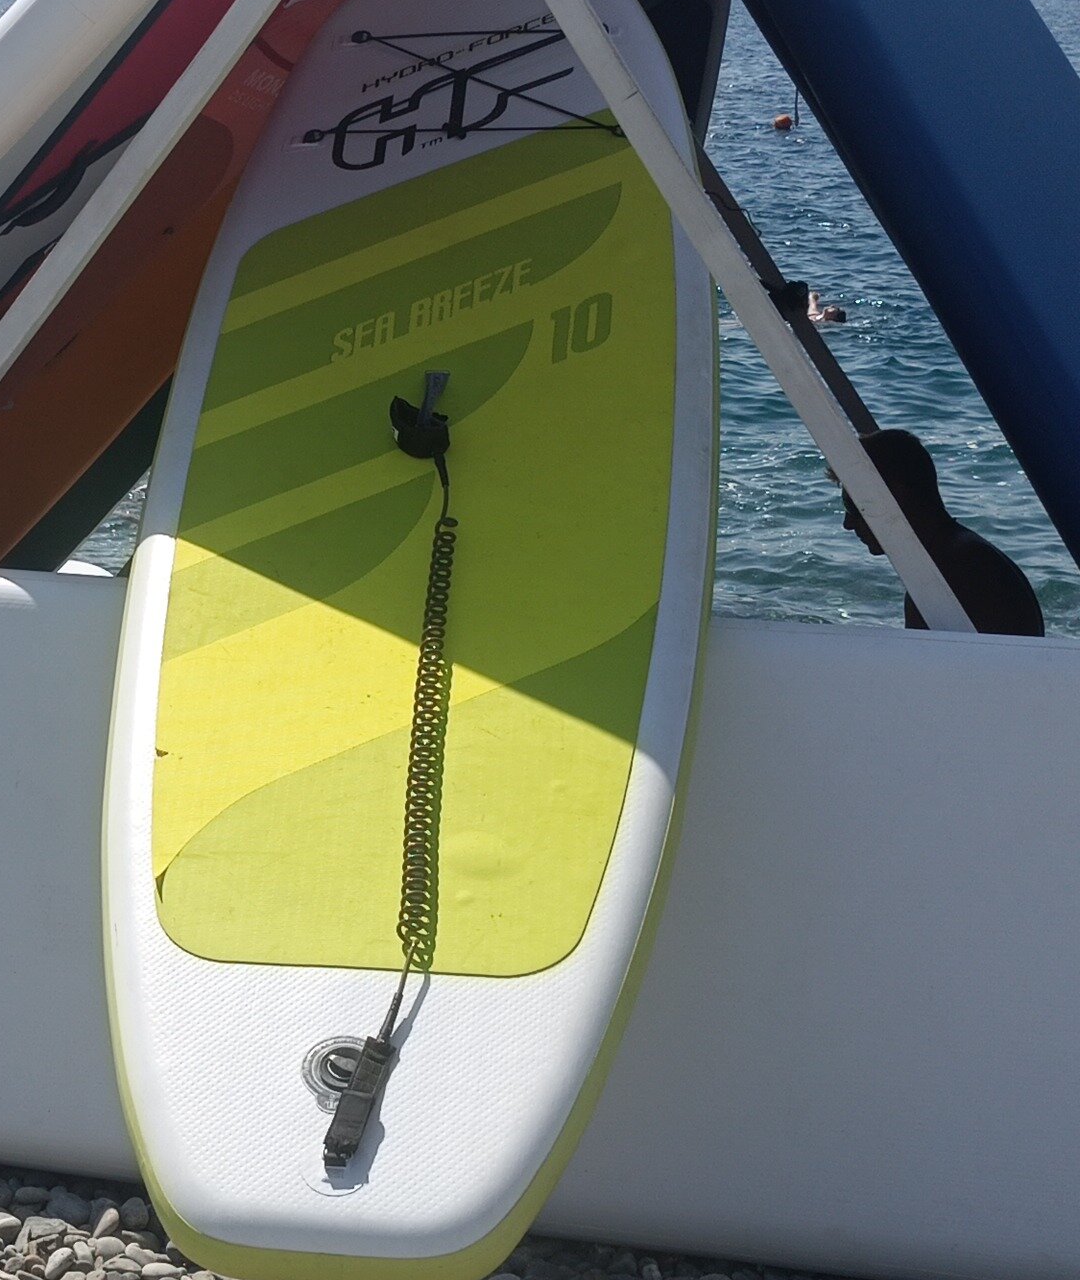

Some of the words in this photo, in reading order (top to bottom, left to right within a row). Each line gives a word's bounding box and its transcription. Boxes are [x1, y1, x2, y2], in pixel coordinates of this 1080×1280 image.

[331, 310, 396, 363] SEA
[409, 257, 533, 330] BREEZE
[550, 291, 613, 365] 10
